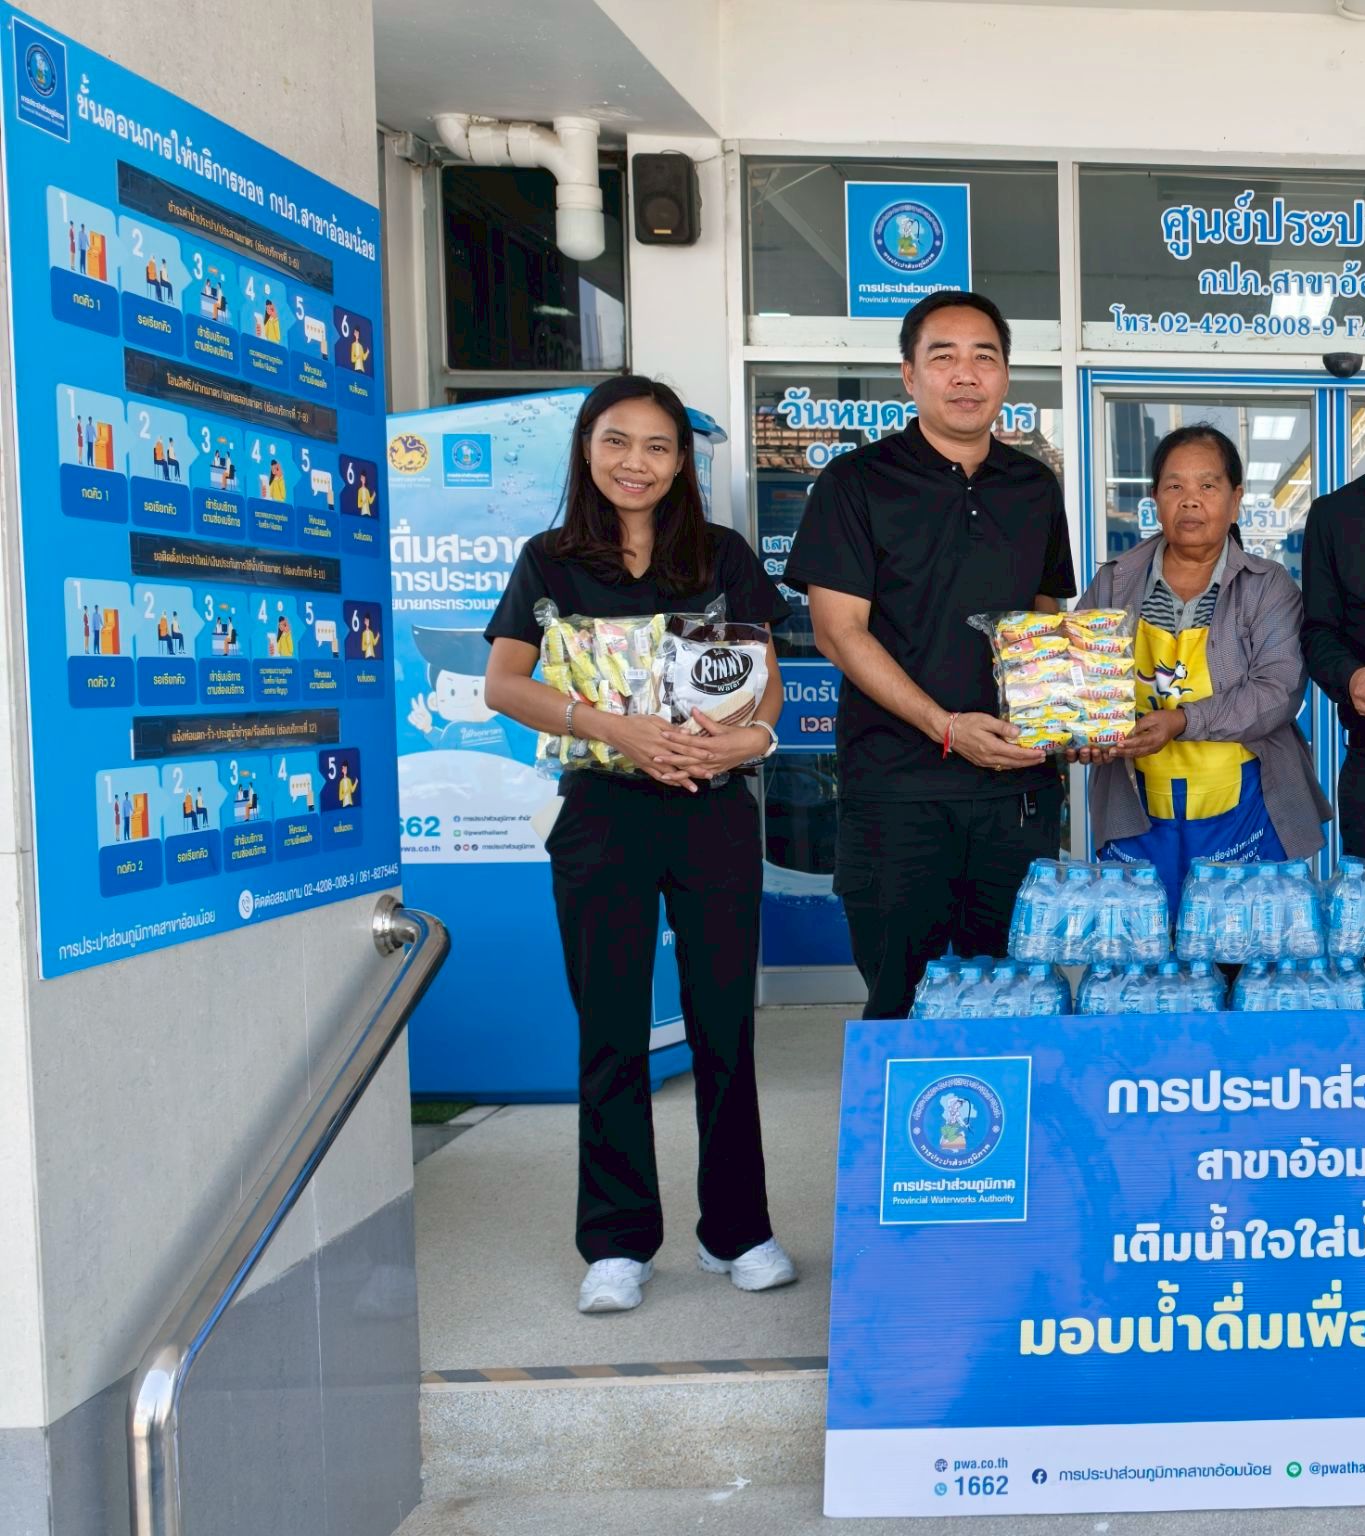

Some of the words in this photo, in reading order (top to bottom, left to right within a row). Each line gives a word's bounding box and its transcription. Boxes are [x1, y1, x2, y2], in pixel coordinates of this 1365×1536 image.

[76, 73, 264, 207] ขั้นตอนการให้บริการของ
[270, 192, 376, 262] กปภ.สาขาอ้อมน้อย
[60, 192, 68, 223] 1
[132, 227, 144, 257] 2
[193, 252, 203, 280] 3
[246, 276, 256, 301] 4
[72, 293, 95, 309] กดคิว
[296, 296, 305, 321] 5
[137, 313, 172, 334] รอเรียกคิว
[341, 314, 350, 338] 6
[1110, 303, 1336, 338] โทร.02-420-8008-9
[66, 388, 75, 419] 1
[139, 411, 151, 439] 2
[201, 426, 211, 453] 3
[252, 439, 261, 463] 4
[301, 448, 310, 472] 5
[347, 462, 355, 485] 6
[81, 487, 102, 500] กดคิว
[144, 500, 177, 516] รอเรียกคิว
[73, 581, 82, 610] 1
[144, 591, 155, 619] 2
[204, 595, 214, 621] 3
[258, 599, 268, 624] 4
[305, 601, 314, 625] 5
[351, 609, 360, 632] 6
[700, 648, 744, 684] RINNY
[87, 674, 108, 688] กดคิว
[153, 672, 186, 685] รอเรียกคิว
[230, 760, 238, 785] 3
[277, 758, 287, 781] 4
[328, 757, 336, 780] 5
[104, 776, 112, 803] 1
[172, 767, 184, 795] 2
[177, 848, 208, 863] รอเรียกคิว
[116, 861, 136, 875] กดคิว
[254, 886, 302, 910] ติดต่อสอบถาม
[303, 873, 354, 897] 02-4208-008-9
[58, 909, 216, 961] การประปาส่วนภูมิภาคสาขาอ้อมน้อย
[893, 1177, 1016, 1193] การประปาส่วนภูมิภาค
[892, 1196, 928, 1206] Provincial
[930, 1195, 977, 1204] Waterworks
[978, 1194, 1015, 1203] Authority
[954, 1457, 1008, 1471] pwa.co.th
[1059, 1462, 1272, 1483] การประปาส่วนภูมิภาคสาขาอ้อมน้อย
[954, 1475, 1009, 1496] 1662
